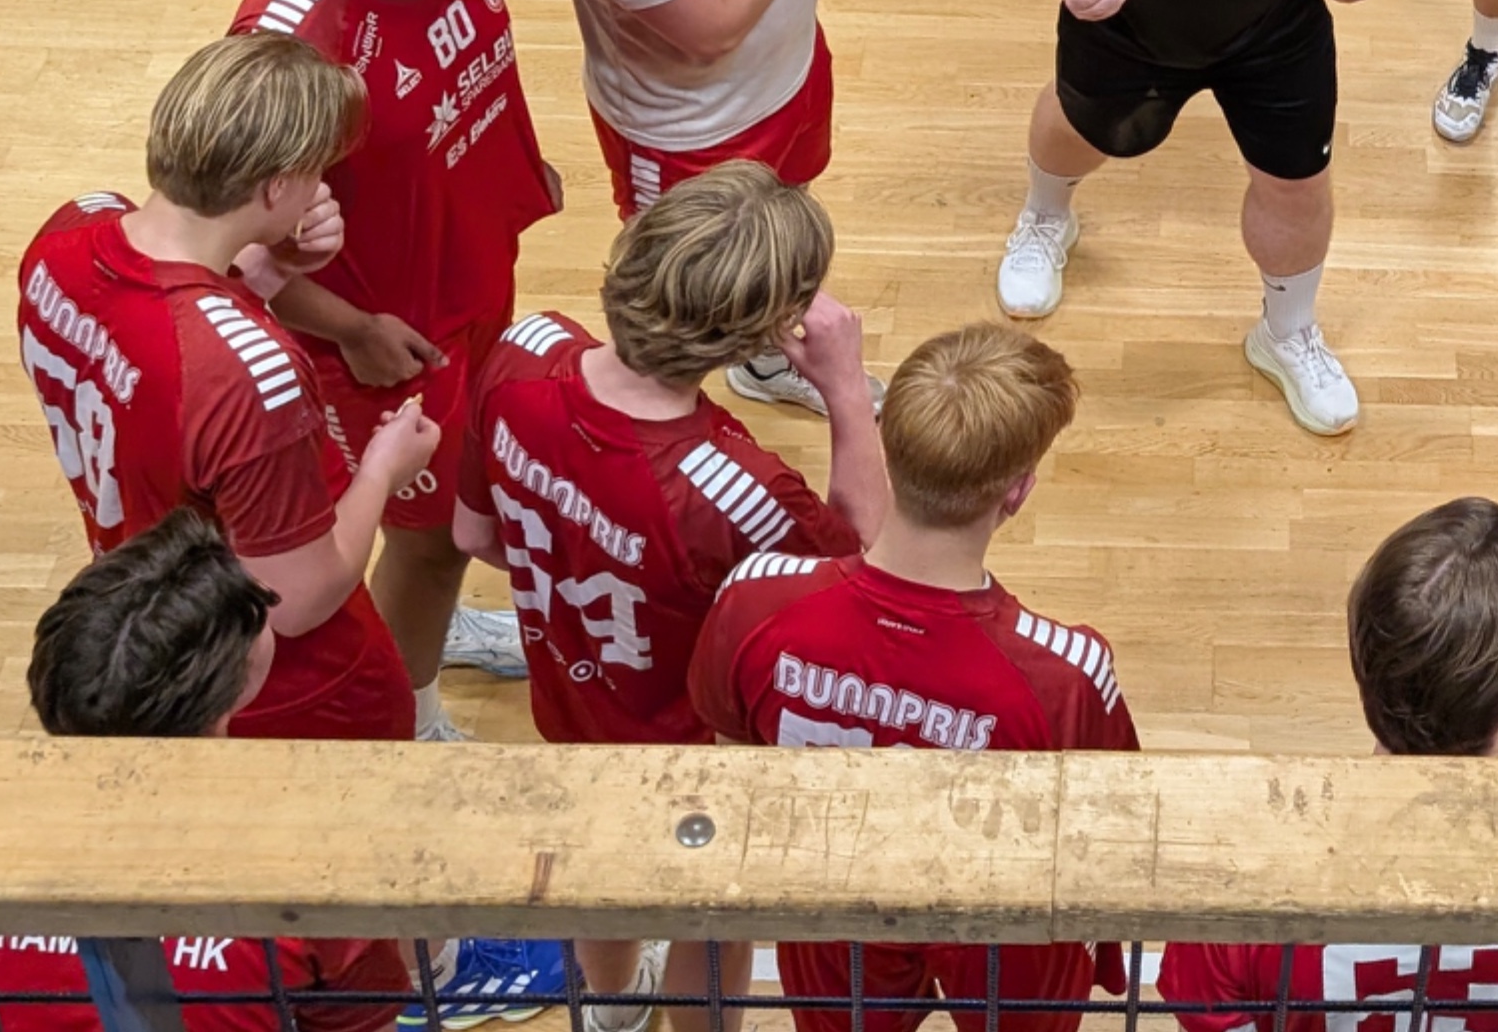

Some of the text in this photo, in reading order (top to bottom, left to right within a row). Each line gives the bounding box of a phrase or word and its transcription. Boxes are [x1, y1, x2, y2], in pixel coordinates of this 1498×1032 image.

[22, 322, 125, 529] 58
[773, 650, 998, 751] BUNNPRIS
[173, 936, 235, 972] HK
